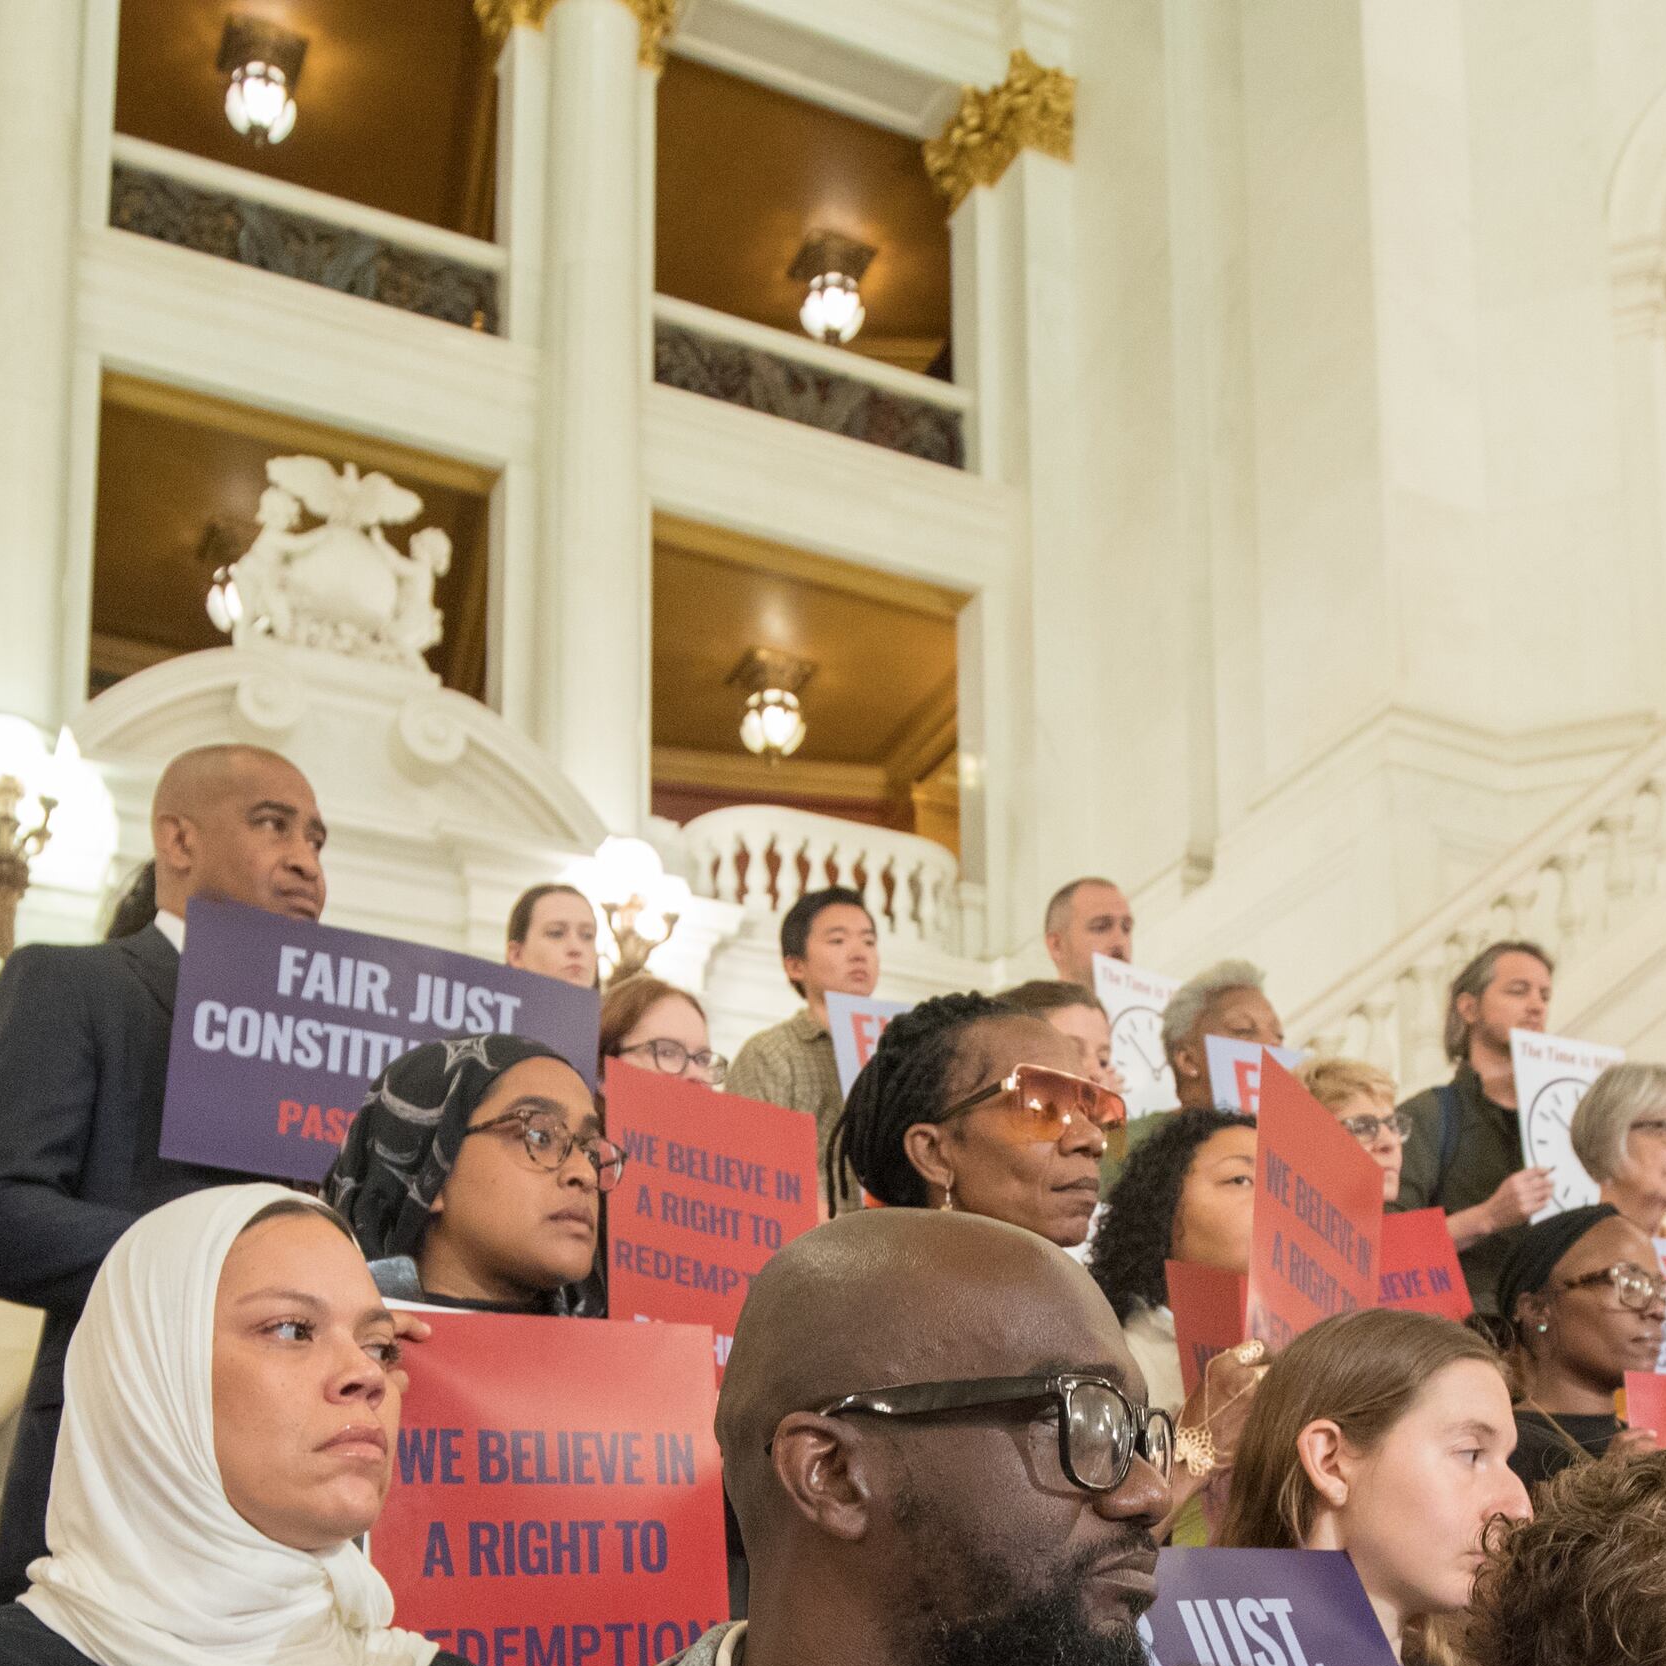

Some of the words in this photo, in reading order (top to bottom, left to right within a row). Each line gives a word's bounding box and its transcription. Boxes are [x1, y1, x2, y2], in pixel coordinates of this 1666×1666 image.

[277, 945, 398, 1017] FAIR.
[409, 973, 522, 1034] JUST
[193, 1000, 421, 1081] CONSTIT
[277, 1100, 357, 1146] PAS
[622, 1127, 659, 1169] WE
[667, 1141, 766, 1197] BELIEVE
[775, 1170, 802, 1203] IN
[636, 1183, 653, 1219] A
[661, 1191, 742, 1242] RIGHT
[749, 1213, 782, 1251] TO
[1265, 1148, 1291, 1209] WE
[1294, 1174, 1354, 1265] BELIEVE
[613, 1238, 759, 1296] REDEMP
[1379, 1268, 1426, 1305] IEVE
[1428, 1266, 1452, 1294] IN
[397, 1429, 465, 1485] WE
[477, 1428, 644, 1485] BELIEVE
[656, 1434, 695, 1485] IN
[423, 1522, 454, 1577] A
[468, 1521, 606, 1577] RIGHT
[616, 1520, 668, 1574] TO
